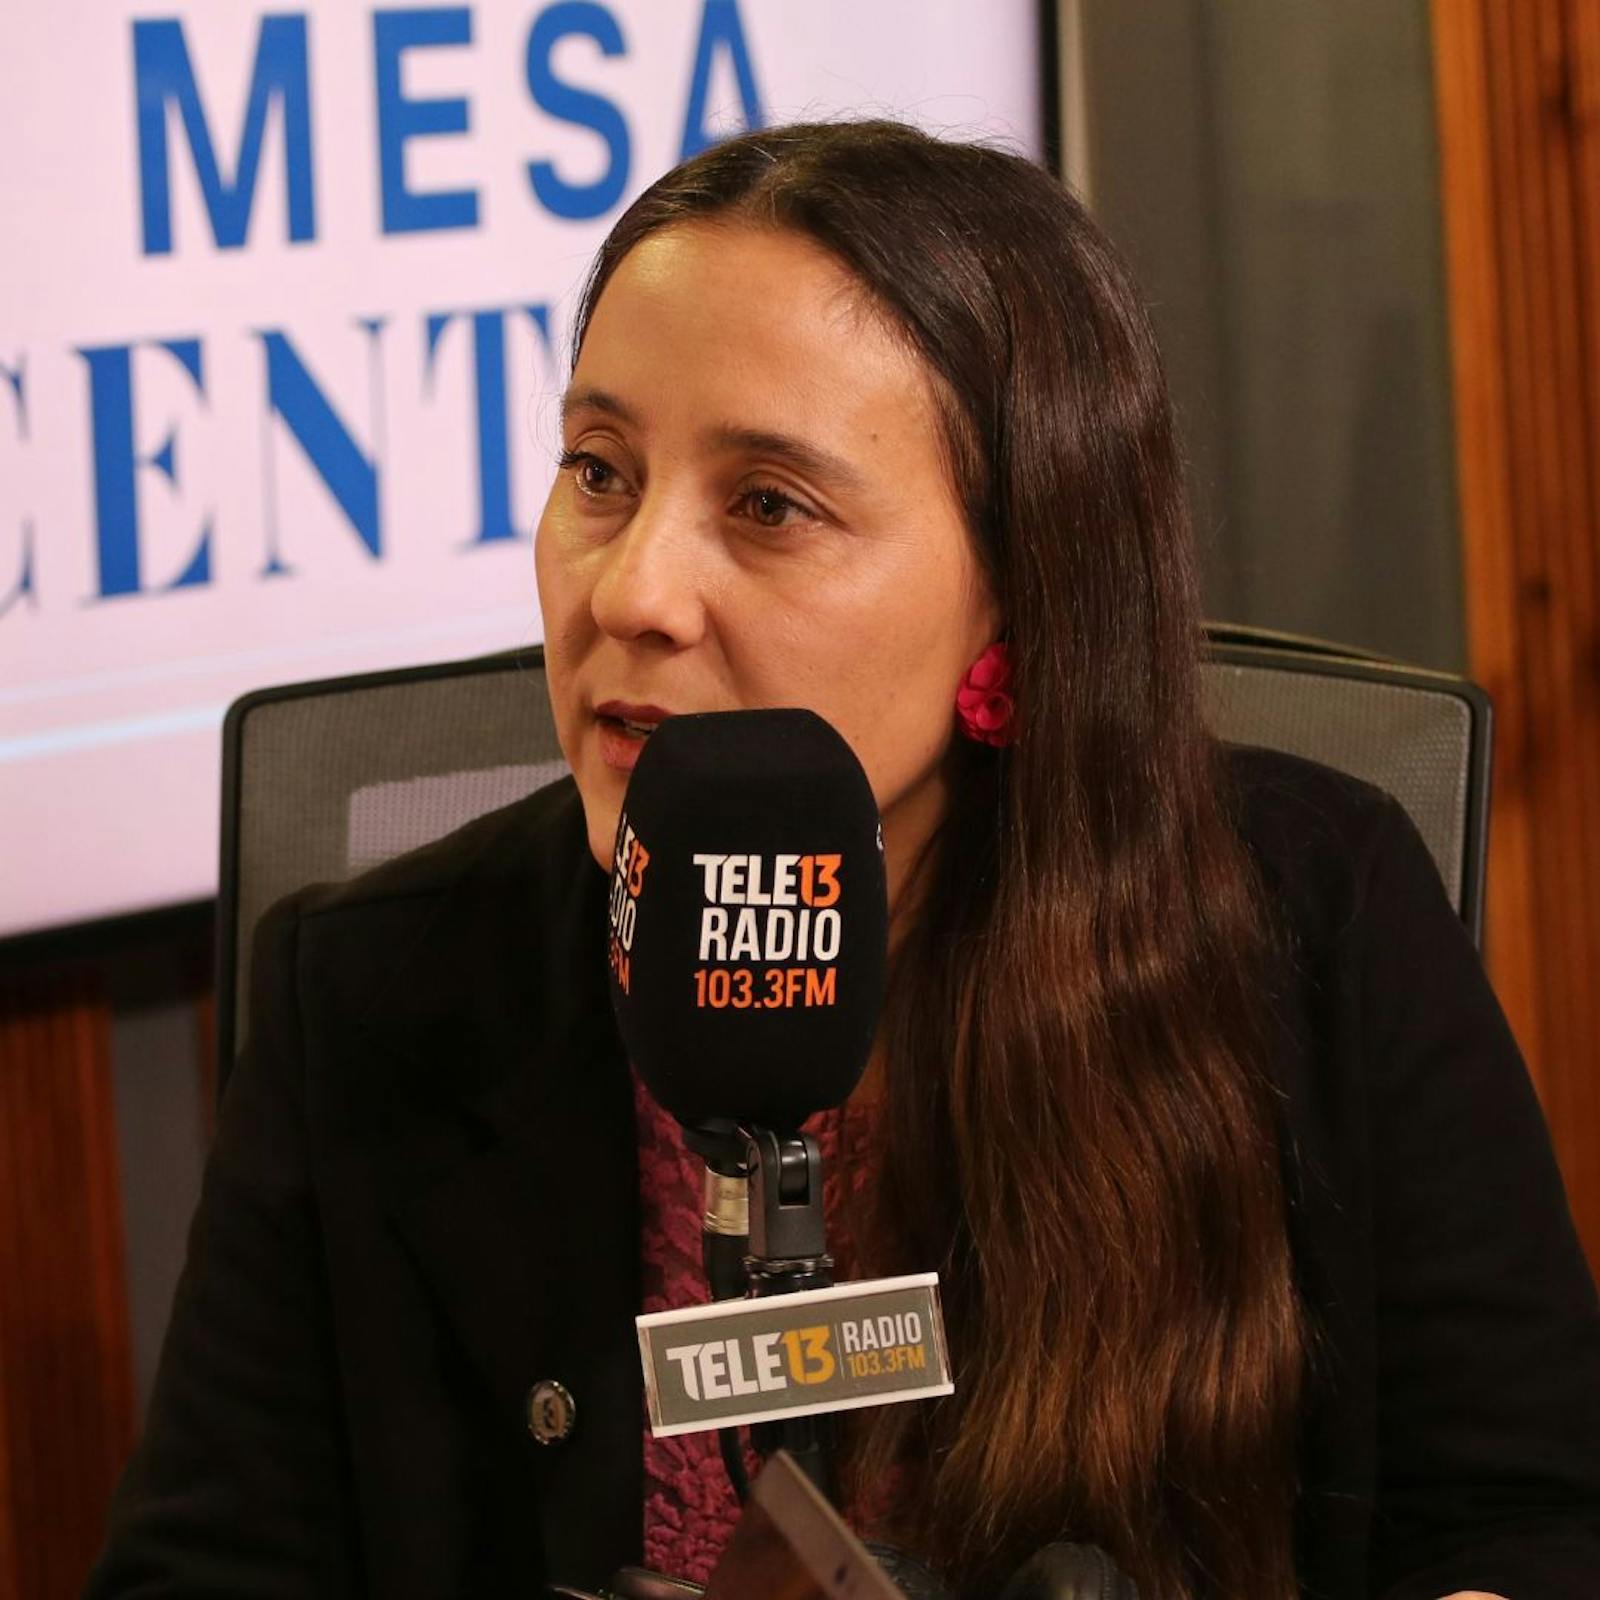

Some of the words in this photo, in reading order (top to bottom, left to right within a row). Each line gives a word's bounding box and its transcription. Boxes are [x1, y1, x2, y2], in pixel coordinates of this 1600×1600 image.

[130, 0, 768, 258] MESA
[0, 300, 556, 620] ENT
[693, 853, 842, 908] TELE13
[698, 907, 842, 962] RADIO
[693, 966, 838, 1009] 103.3FM
[841, 1311, 923, 1354] RADIO
[665, 1325, 836, 1401] TELE13
[846, 1344, 926, 1378] 103.3FM
